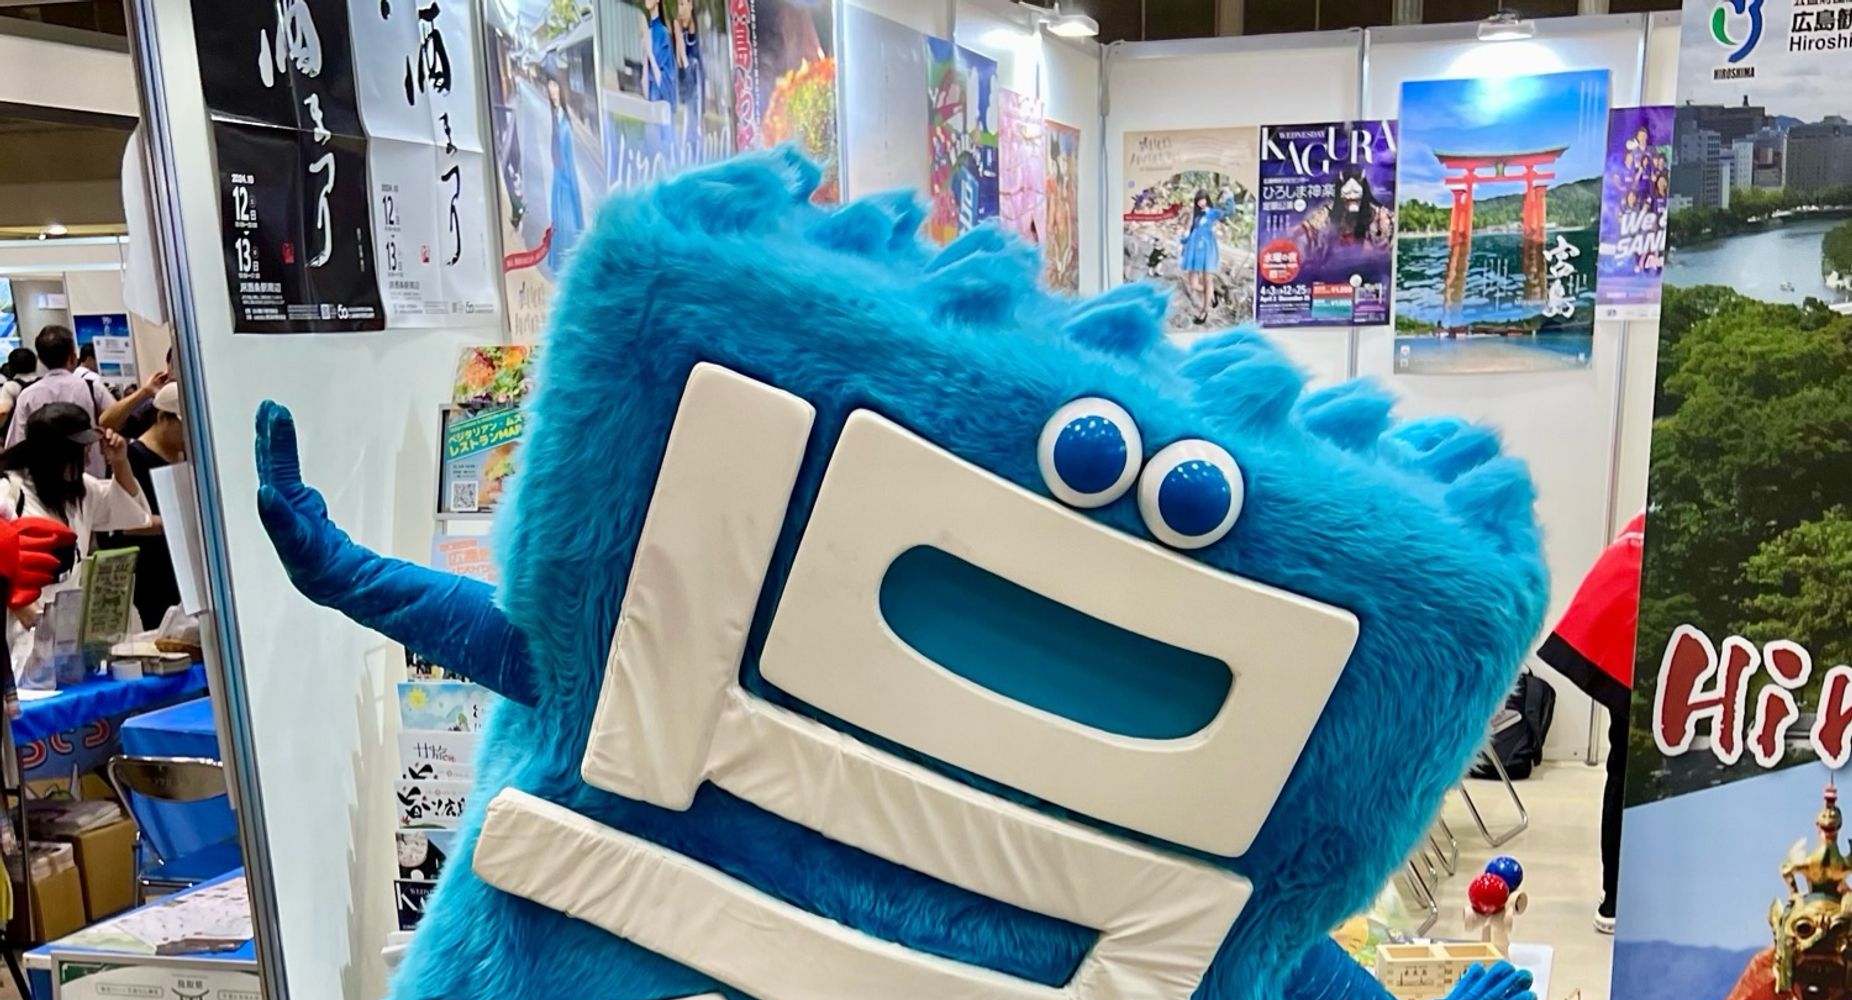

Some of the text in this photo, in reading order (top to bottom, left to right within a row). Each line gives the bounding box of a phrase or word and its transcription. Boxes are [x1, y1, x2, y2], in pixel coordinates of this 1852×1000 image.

[1713, 67, 1755, 80] HIROSHIMA
[1261, 120, 1397, 177] KAGURA
[1279, 131, 1325, 139] WEDNESDAY
[232, 186, 250, 221] 12
[1263, 184, 1336, 199] ひろしま神楽
[383, 196, 394, 225] 12
[235, 238, 252, 272] 13
